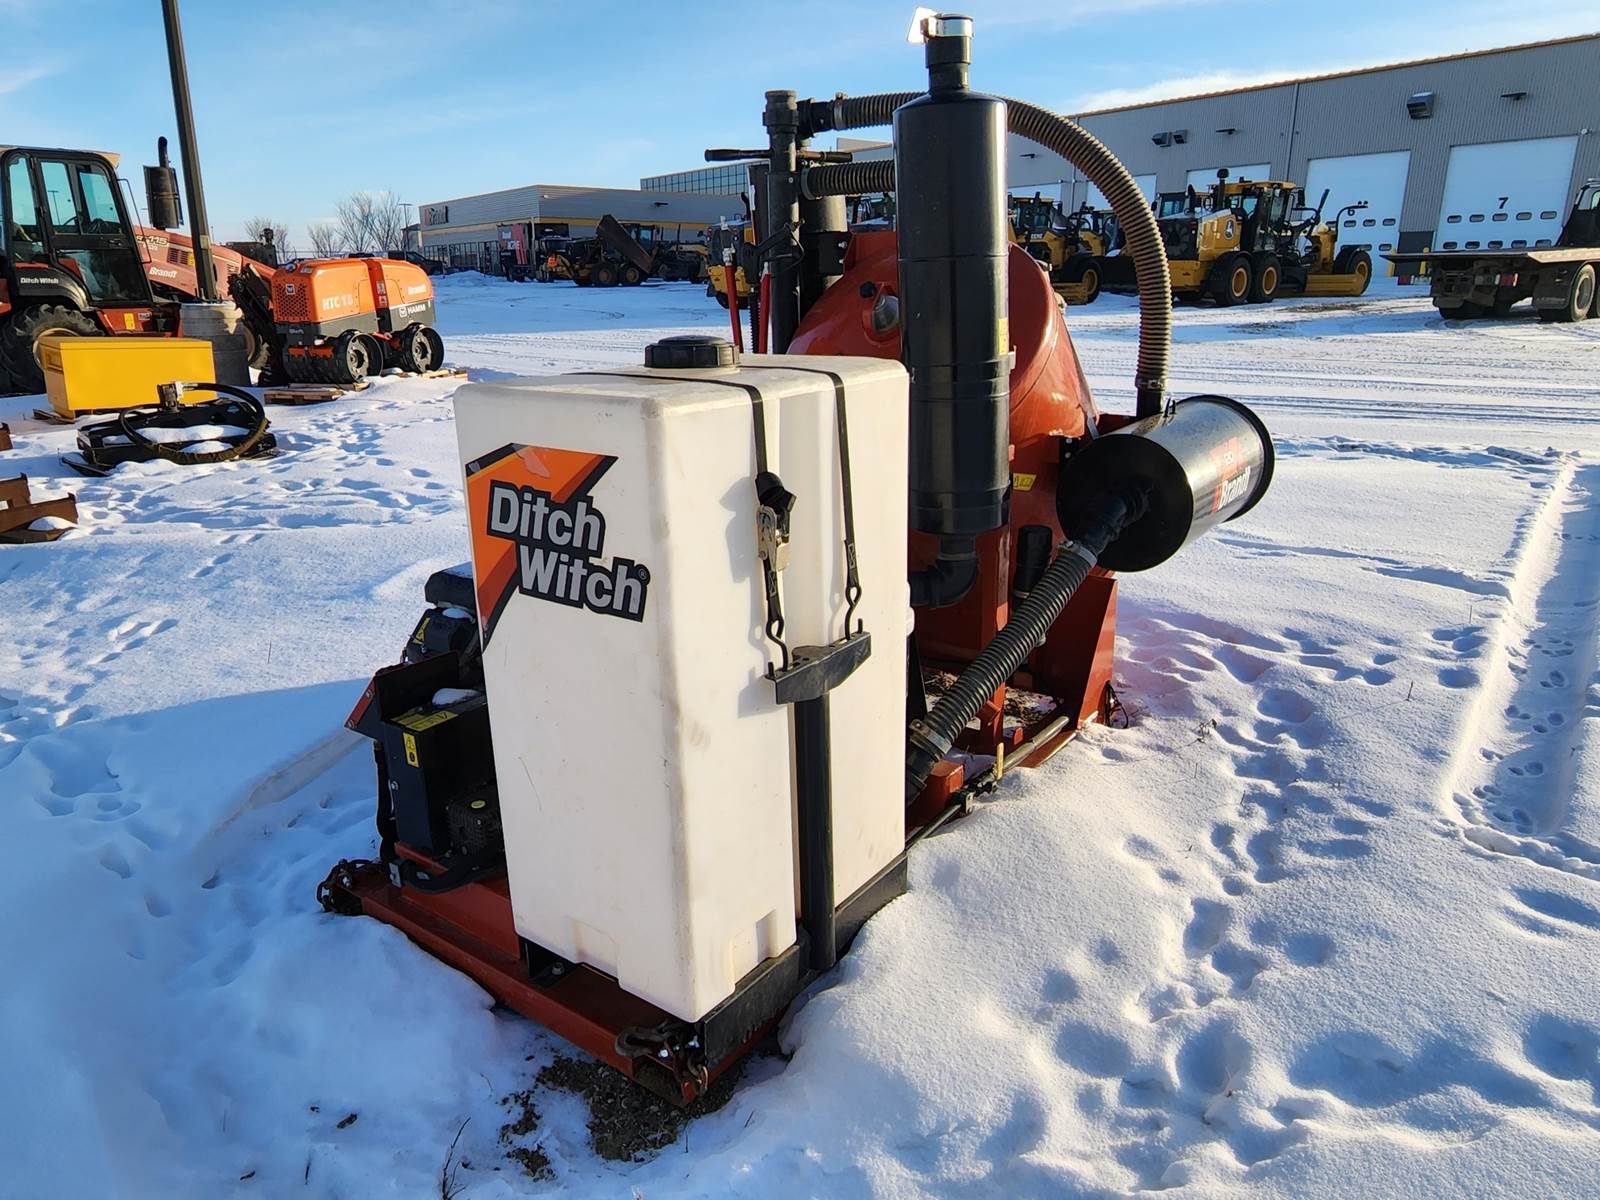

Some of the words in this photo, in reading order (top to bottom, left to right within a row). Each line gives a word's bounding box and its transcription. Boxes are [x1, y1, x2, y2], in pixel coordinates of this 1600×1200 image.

[1499, 196, 1509, 210] 7
[322, 296, 341, 311] HTC
[407, 303, 426, 313] HAMM
[490, 486, 602, 552] Ditch
